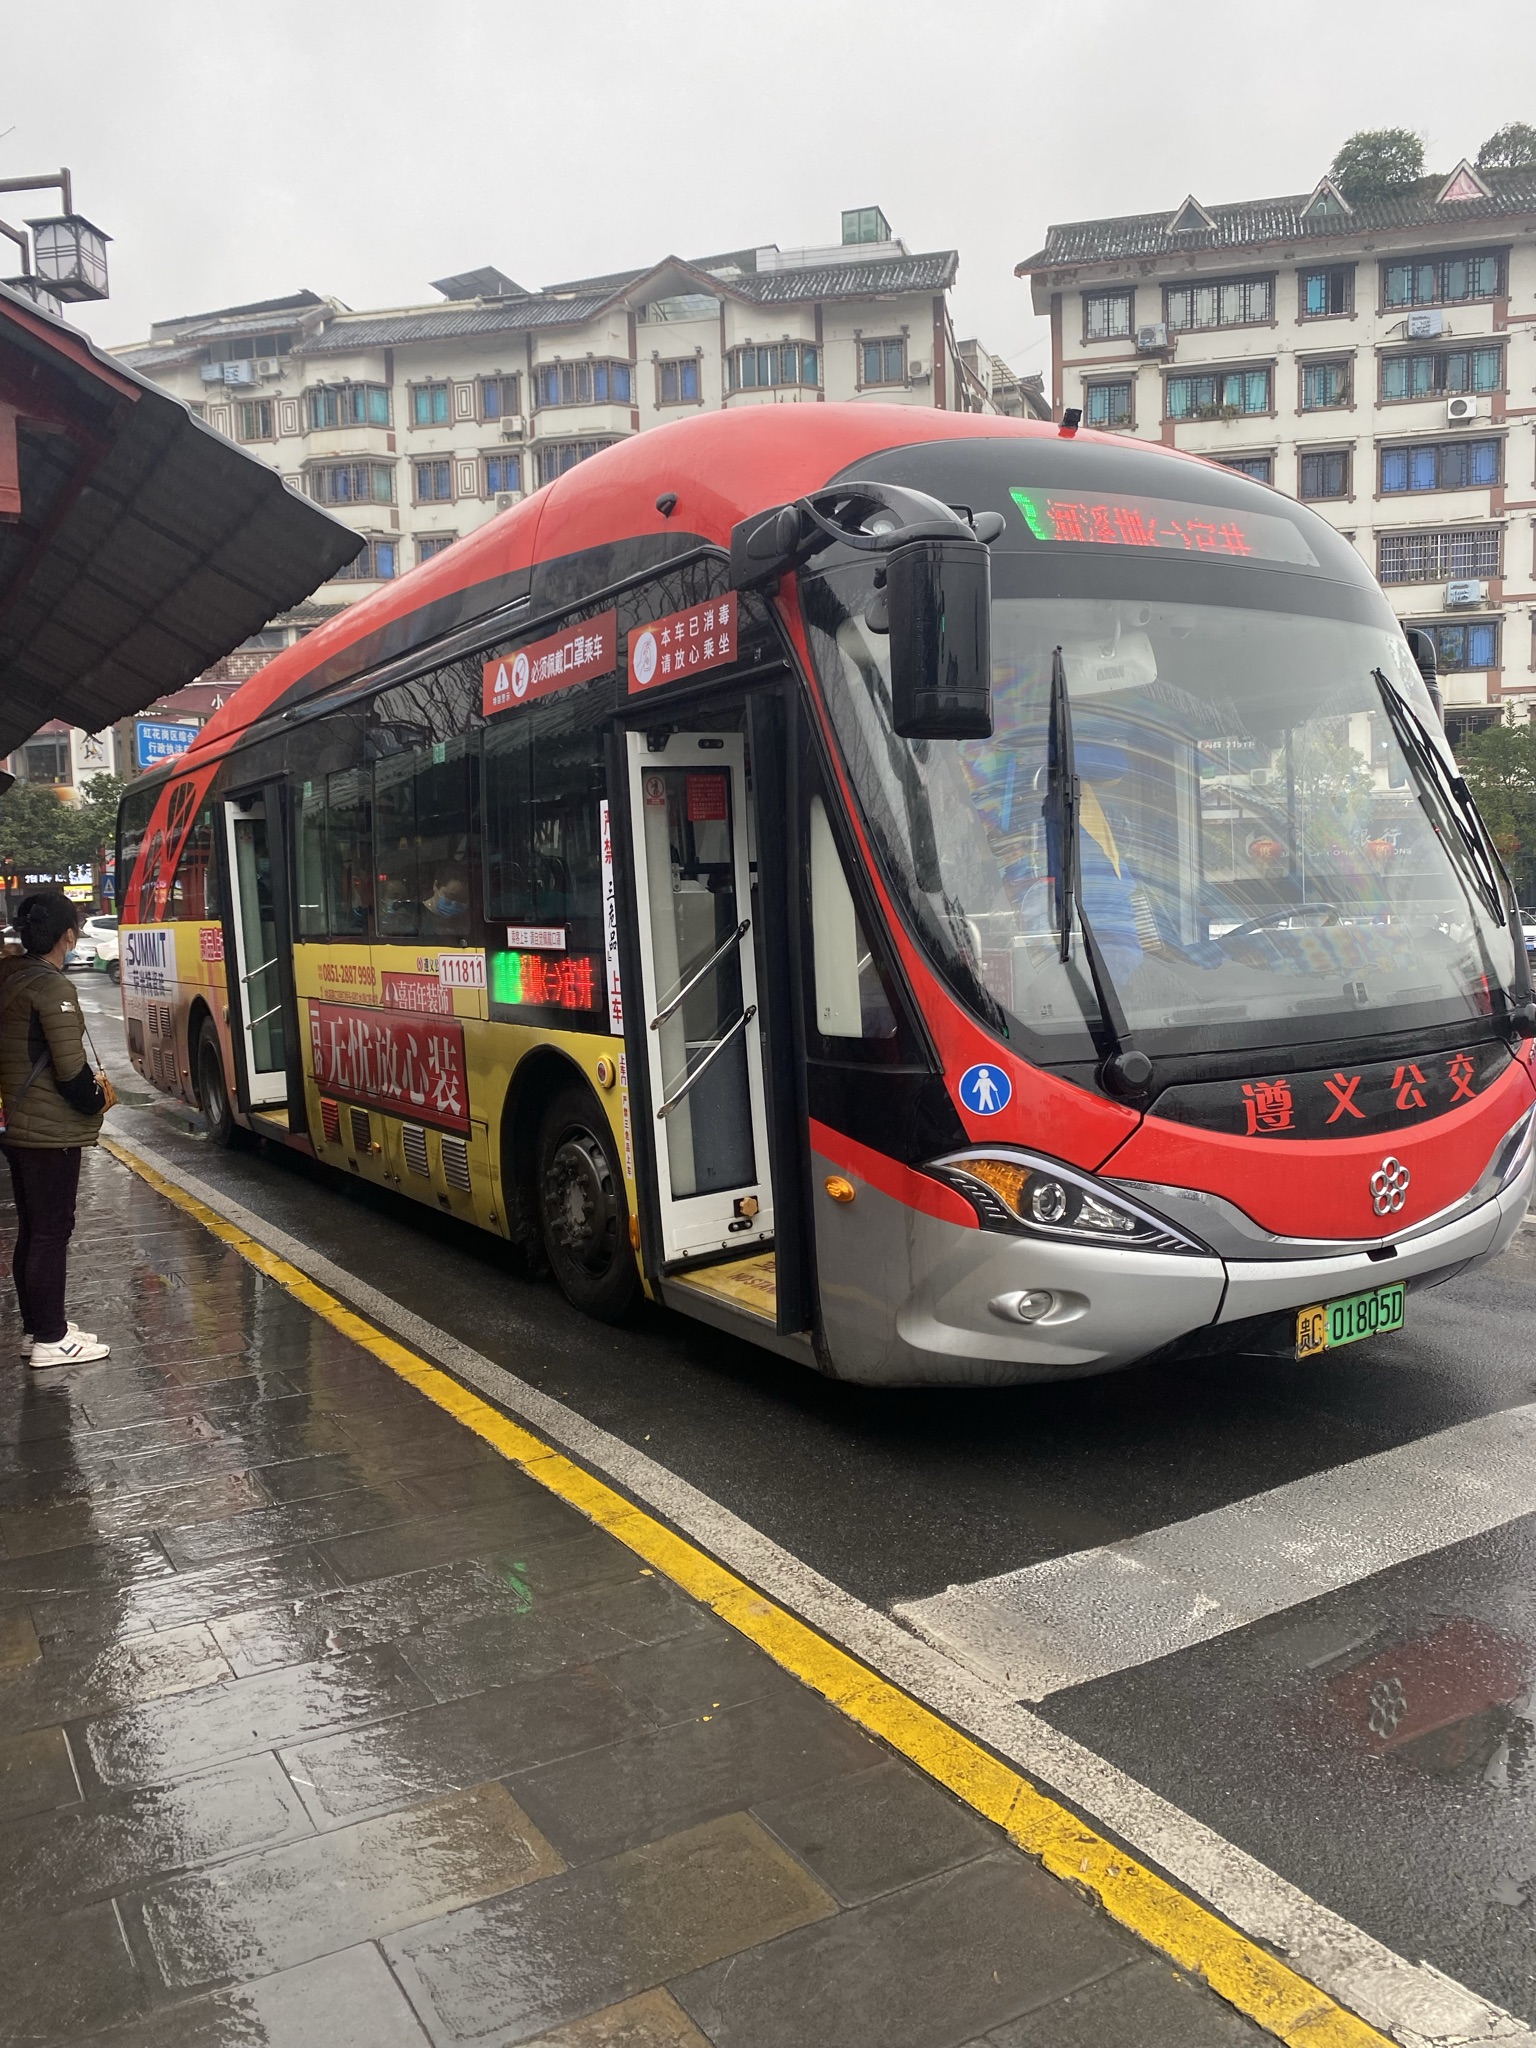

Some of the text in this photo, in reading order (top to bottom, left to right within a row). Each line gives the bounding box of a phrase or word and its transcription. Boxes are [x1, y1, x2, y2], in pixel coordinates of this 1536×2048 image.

[661, 604, 730, 648] 本车已消毒
[531, 634, 603, 684] 必须佩戴口罩乘车
[661, 633, 730, 674] 请放心乘坐
[143, 727, 196, 743] 红花岗区综合
[127, 932, 166, 968] SUMMIT
[442, 960, 483, 983] 111811
[397, 980, 449, 1014] 喜百年装饰
[310, 1009, 323, 1075] 一口价
[323, 1015, 461, 1116] 无忧放心装
[1242, 1053, 1478, 1136] 遵义公交
